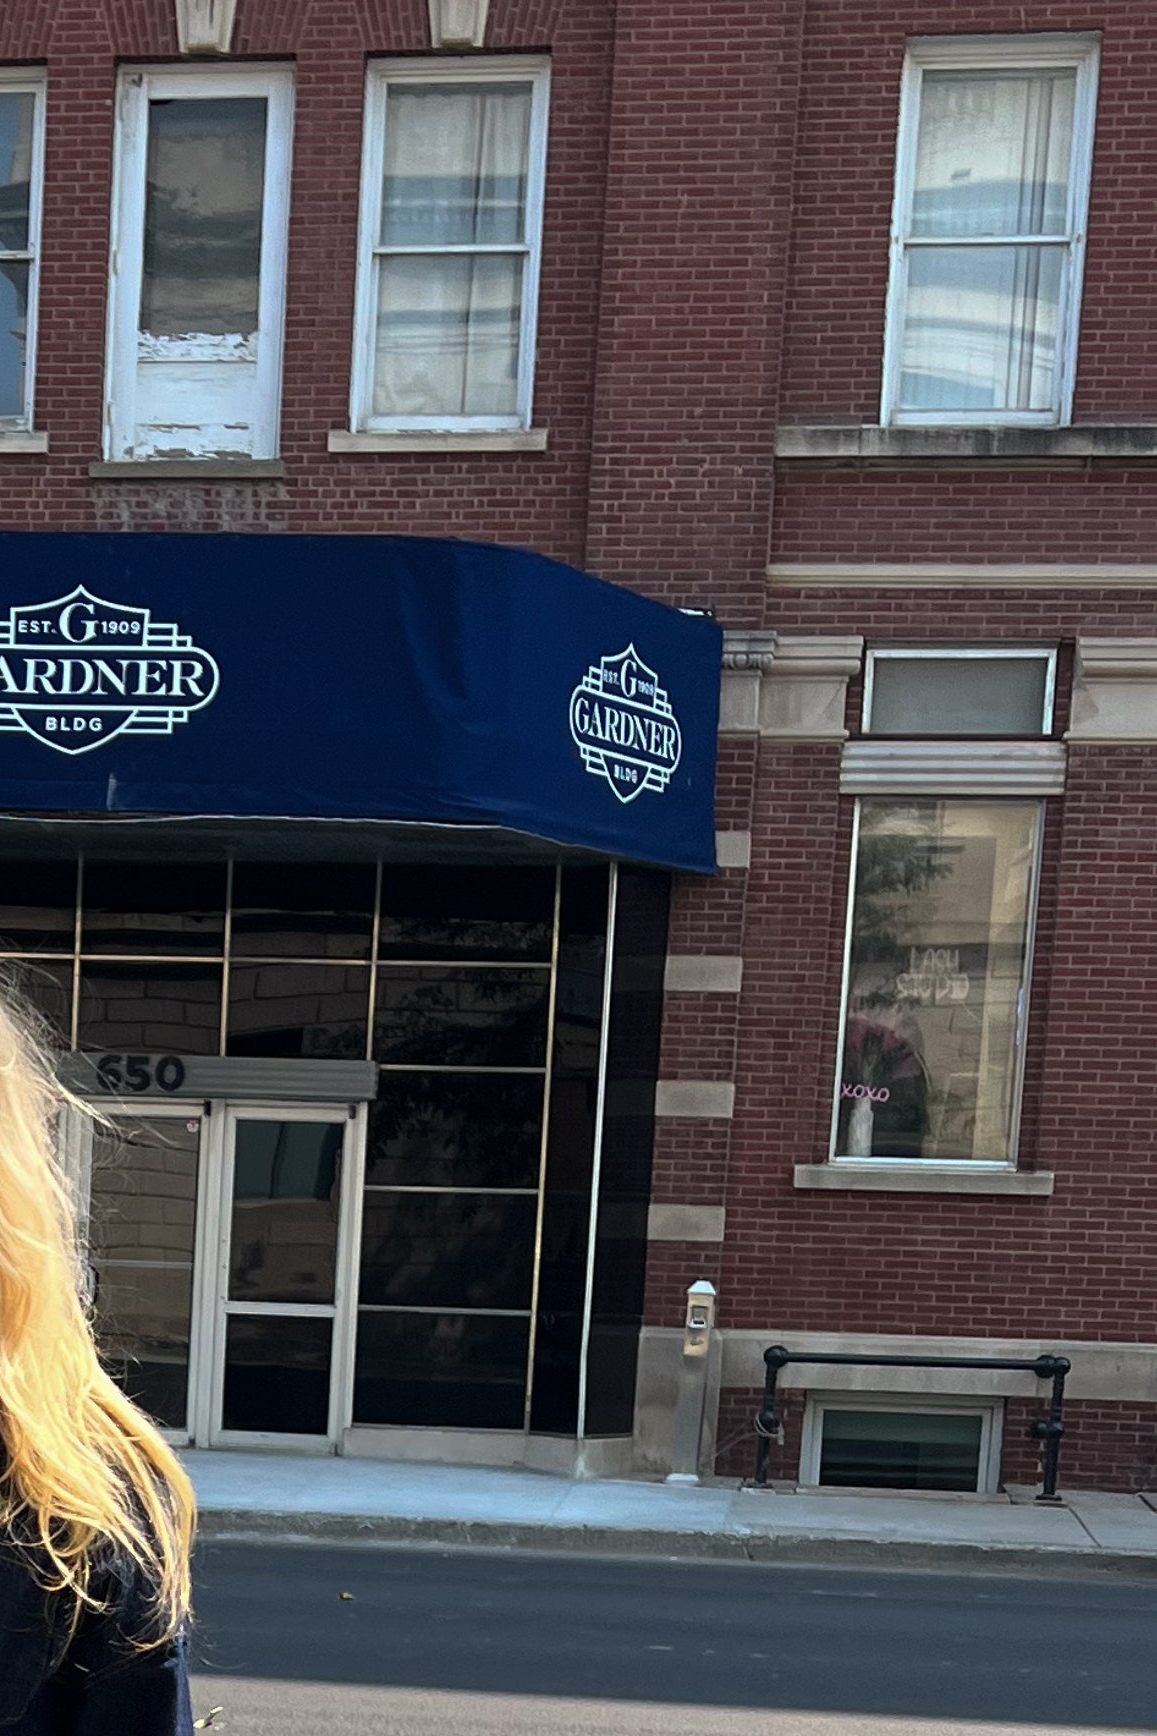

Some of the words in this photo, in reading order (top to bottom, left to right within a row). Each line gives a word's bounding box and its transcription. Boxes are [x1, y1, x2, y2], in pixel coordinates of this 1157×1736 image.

[18, 619, 56, 634] EST.
[58, 602, 99, 643] G
[101, 620, 140, 634] 1909
[620, 658, 638, 698] G
[45, 716, 103, 731] BLDG
[574, 697, 676, 761] GARDNER
[96, 1054, 185, 1091] 650
